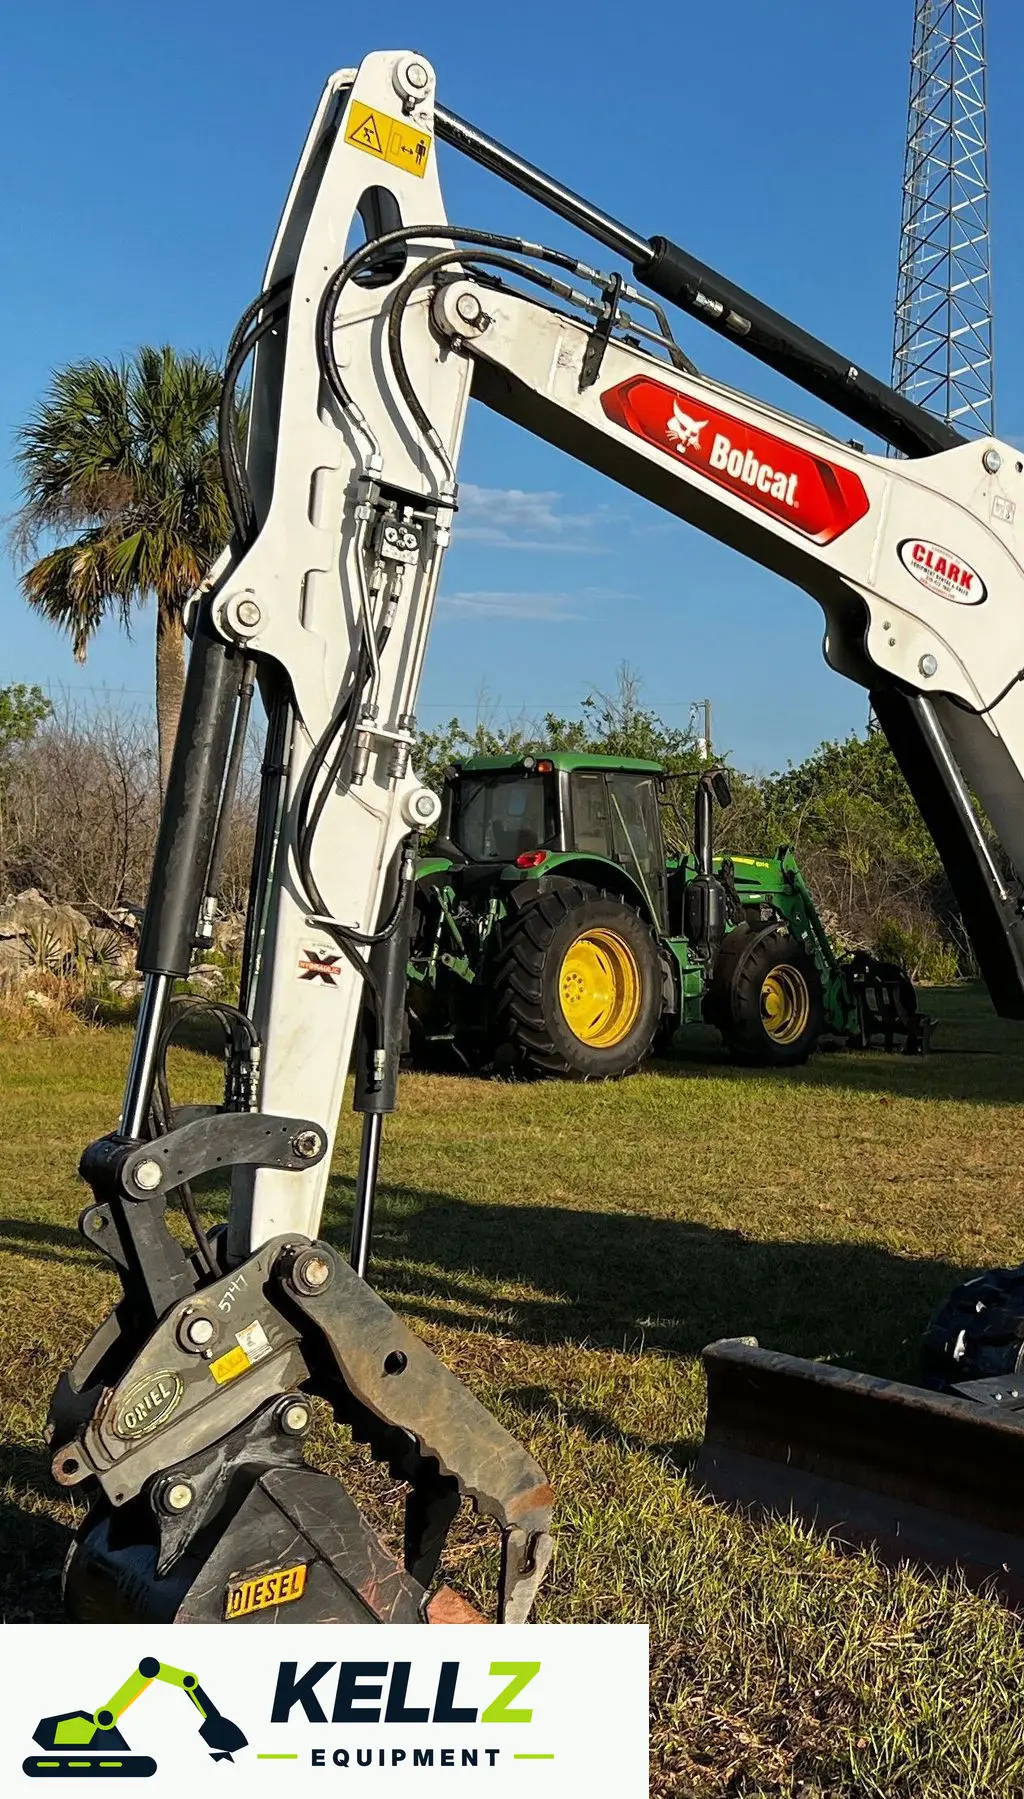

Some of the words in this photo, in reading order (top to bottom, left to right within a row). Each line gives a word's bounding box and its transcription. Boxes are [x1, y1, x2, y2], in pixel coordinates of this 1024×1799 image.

[709, 433, 800, 507] Bobcat
[912, 543, 974, 590] CLARK
[217, 1274, 249, 1314] 5747
[232, 1571, 300, 1612] DIESEL
